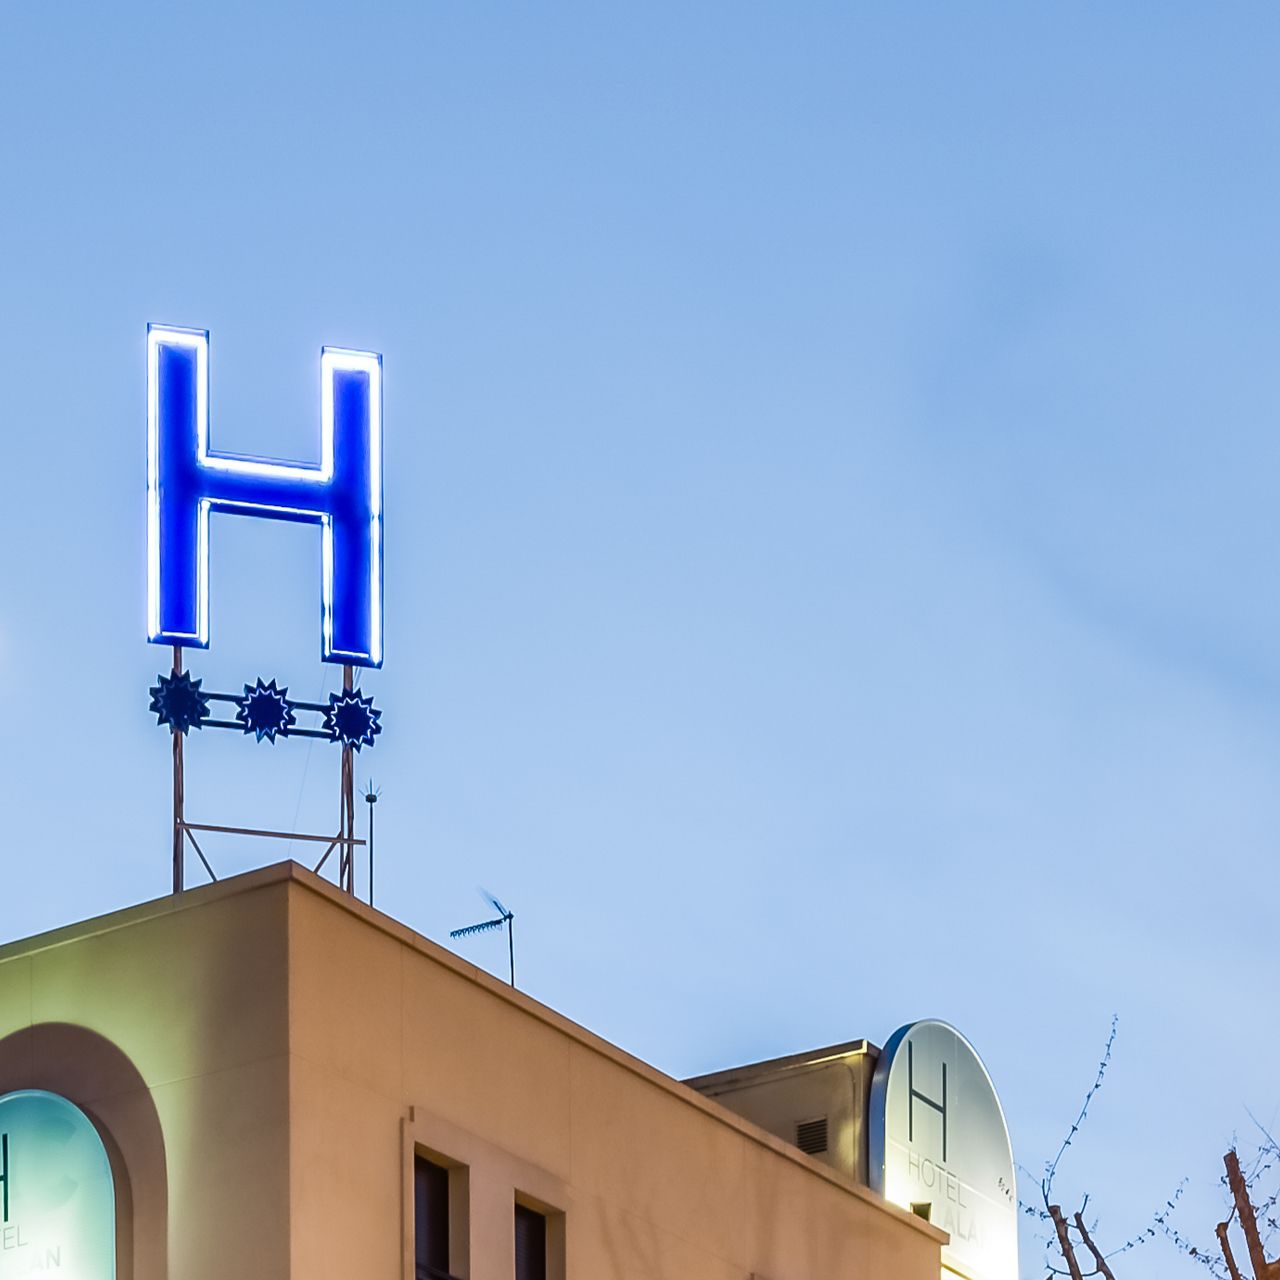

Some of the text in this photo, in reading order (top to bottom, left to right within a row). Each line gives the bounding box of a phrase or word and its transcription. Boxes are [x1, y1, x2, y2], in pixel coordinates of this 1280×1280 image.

[146, 322, 384, 670] H
[908, 1039, 947, 1162] H
[908, 1152, 968, 1209] HOTEL
